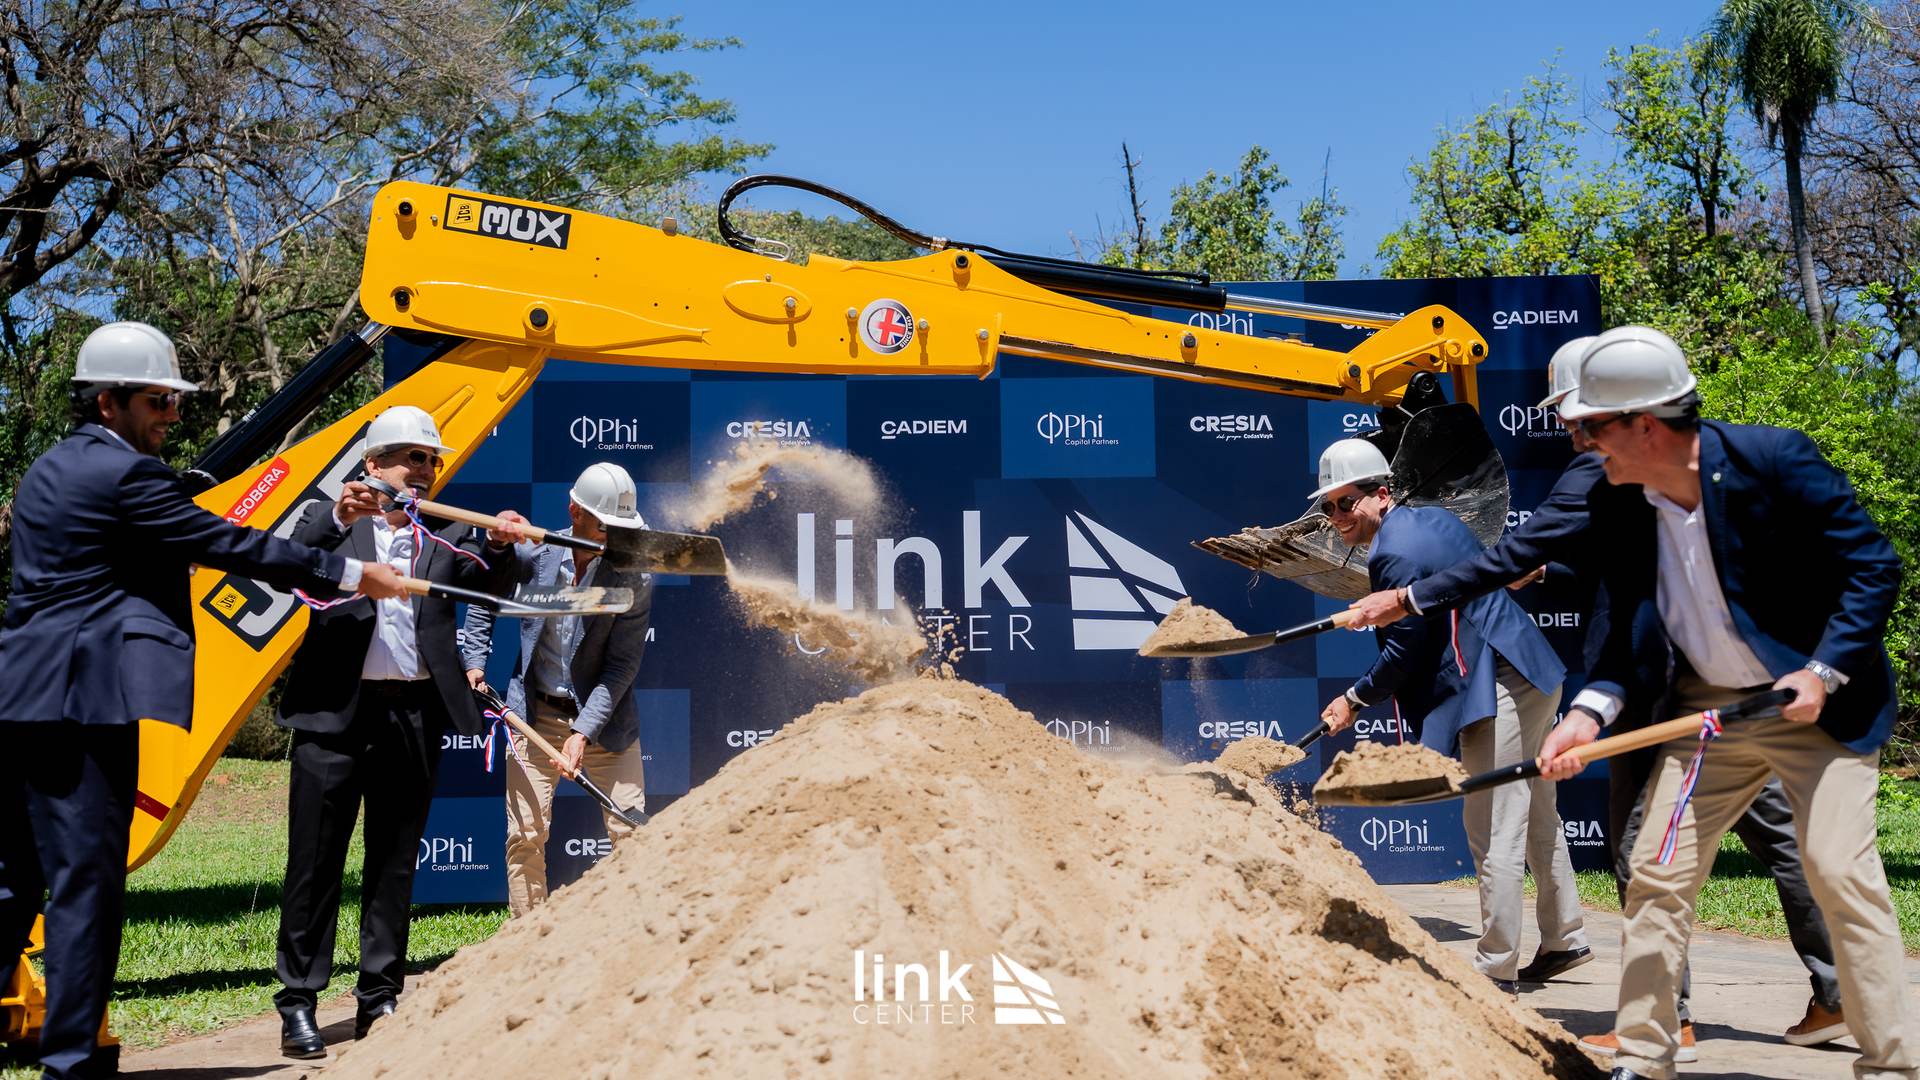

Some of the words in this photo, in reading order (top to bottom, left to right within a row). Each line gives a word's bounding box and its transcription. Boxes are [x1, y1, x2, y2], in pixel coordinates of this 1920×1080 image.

[456, 203, 472, 222] JCB
[482, 204, 565, 248] 3CX
[1492, 310, 1579, 329] CADIEM
[899, 331, 913, 348] SINCE
[726, 420, 810, 438] CRESIA
[881, 420, 967, 439] CADIEM
[1189, 414, 1273, 432] CRESIA
[1064, 438, 1090, 446] Capital
[1527, 430, 1553, 438] Capital
[597, 443, 624, 451] Capital
[233, 466, 286, 520] SOBERA
[797, 510, 1032, 609] link
[220, 591, 238, 610] JCB
[1199, 720, 1284, 739] CRESIA
[1389, 845, 1416, 853] Capital
[1416, 844, 1445, 852] Partners
[431, 863, 459, 872] Capital
[460, 863, 489, 871] Partners
